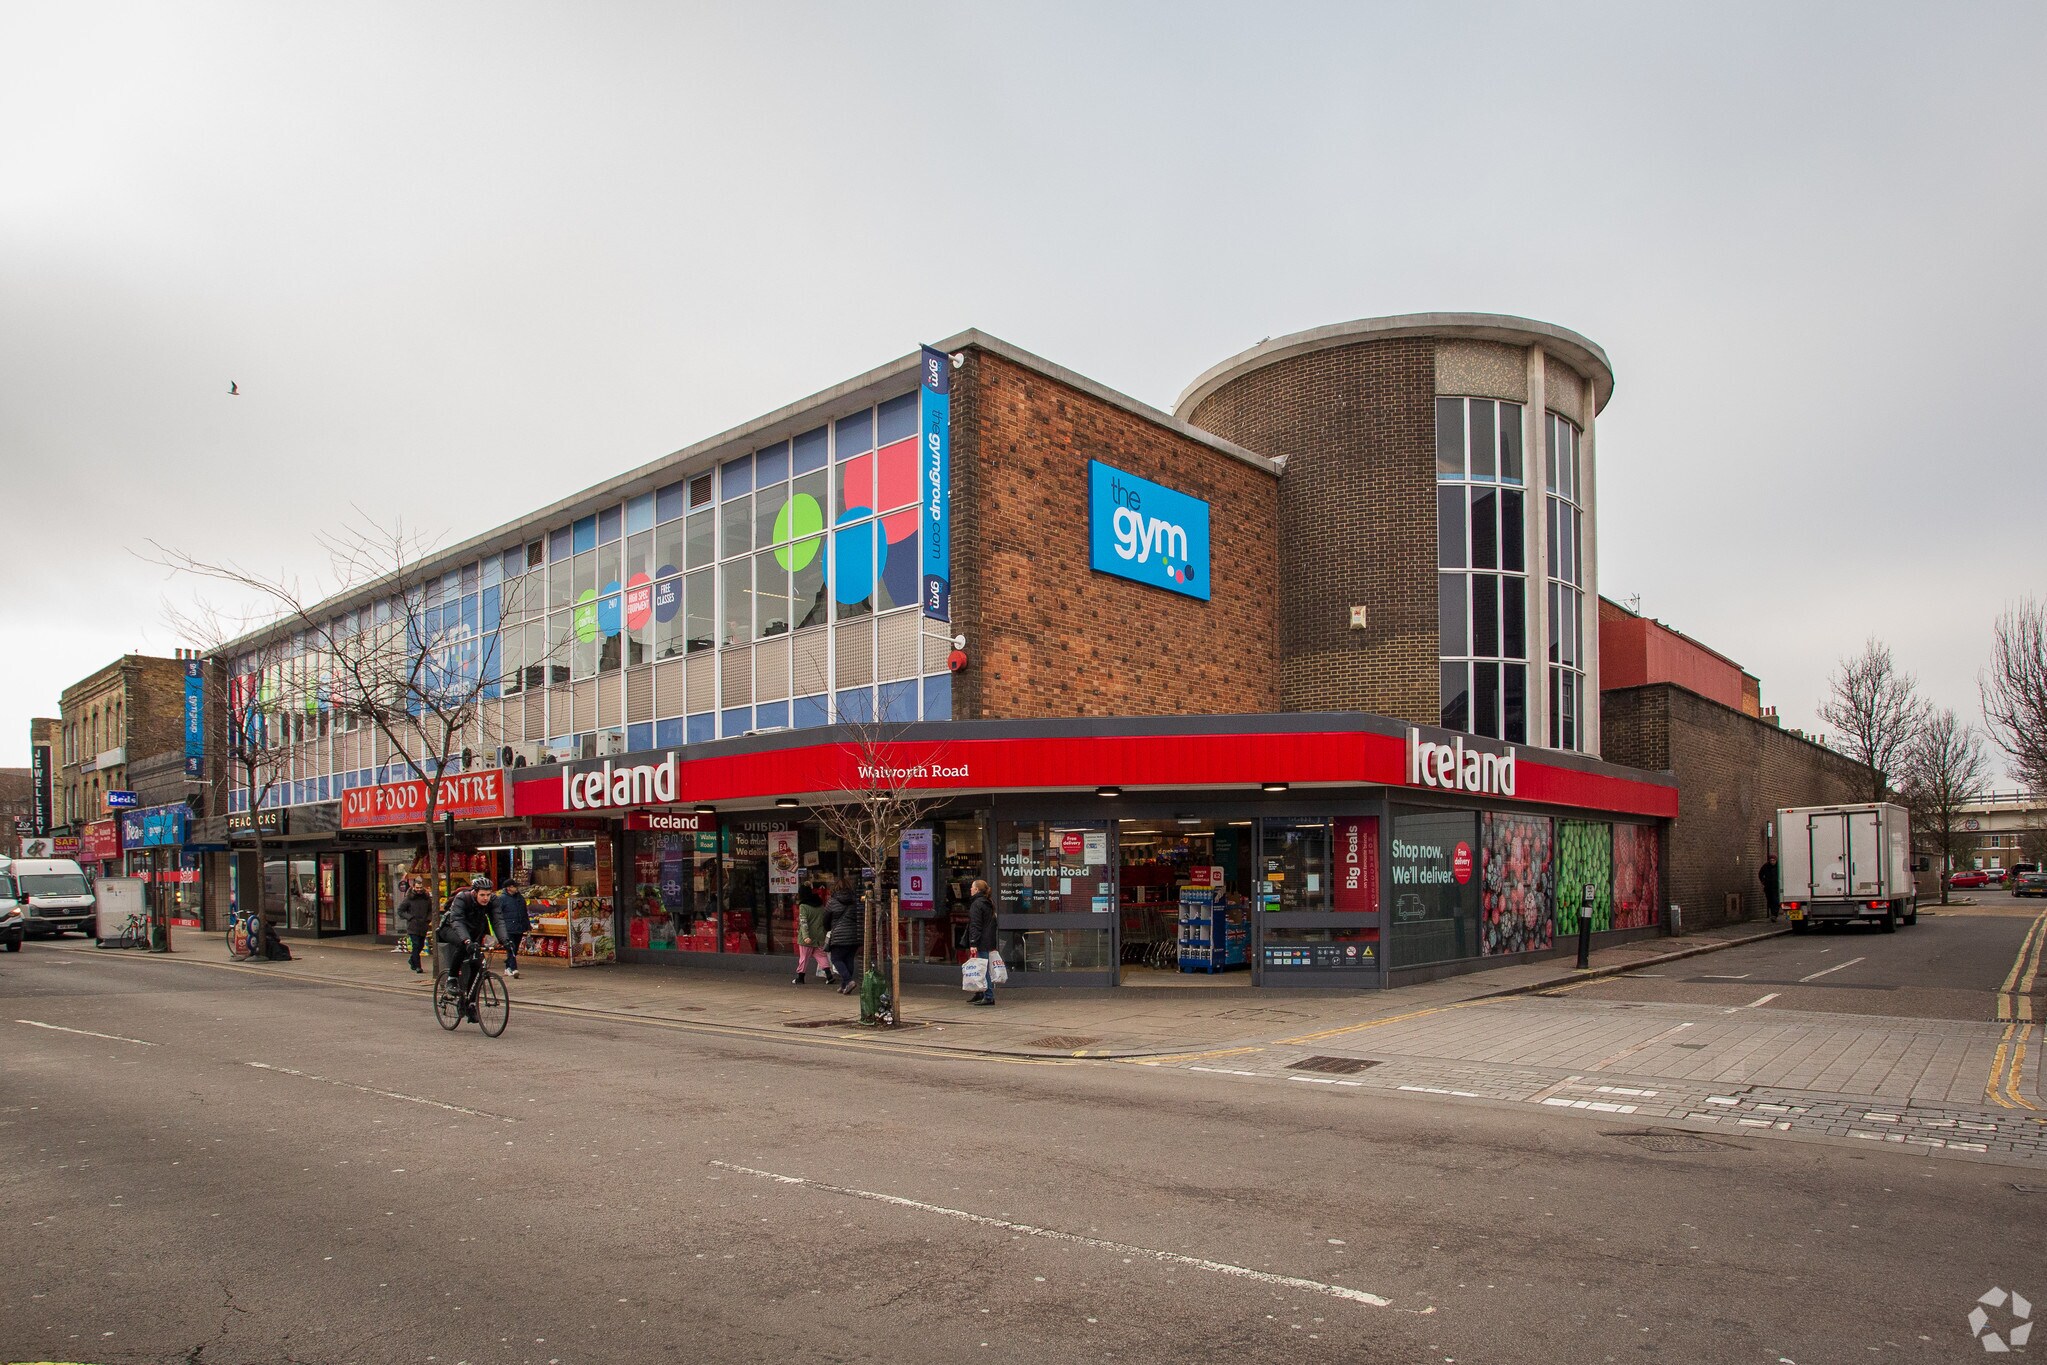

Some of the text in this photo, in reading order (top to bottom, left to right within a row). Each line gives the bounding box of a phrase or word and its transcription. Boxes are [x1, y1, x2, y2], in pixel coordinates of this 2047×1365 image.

[928, 358, 939, 387] gym
[928, 409, 943, 560] thegymgroup.com
[1111, 476, 1141, 511] the
[1113, 506, 1188, 564] gym
[639, 590, 649, 600] SPEC
[661, 583, 671, 595] FREE
[928, 580, 940, 609] gym
[657, 593, 675, 606] CLASSES
[1406, 727, 1516, 796] Iceland
[562, 751, 676, 810] Iceland
[857, 765, 969, 779] Walworth Road
[34, 749, 43, 835] JEWELLERY
[110, 795, 136, 803] Beds
[348, 790, 370, 814] OLI
[376, 785, 418, 811] FOOD
[229, 814, 277, 828] PEACCKS
[649, 814, 699, 829] Iceland
[736, 848, 748, 856] We
[1000, 854, 1040, 865] Hello...
[1346, 825, 1361, 889] Big Deals
[1392, 839, 1443, 862] Shop now.
[1001, 866, 1090, 877] Walworth Road
[1454, 857, 1470, 866] delivery
[1392, 866, 1418, 885] We'll
[1420, 865, 1454, 884] deliver.
